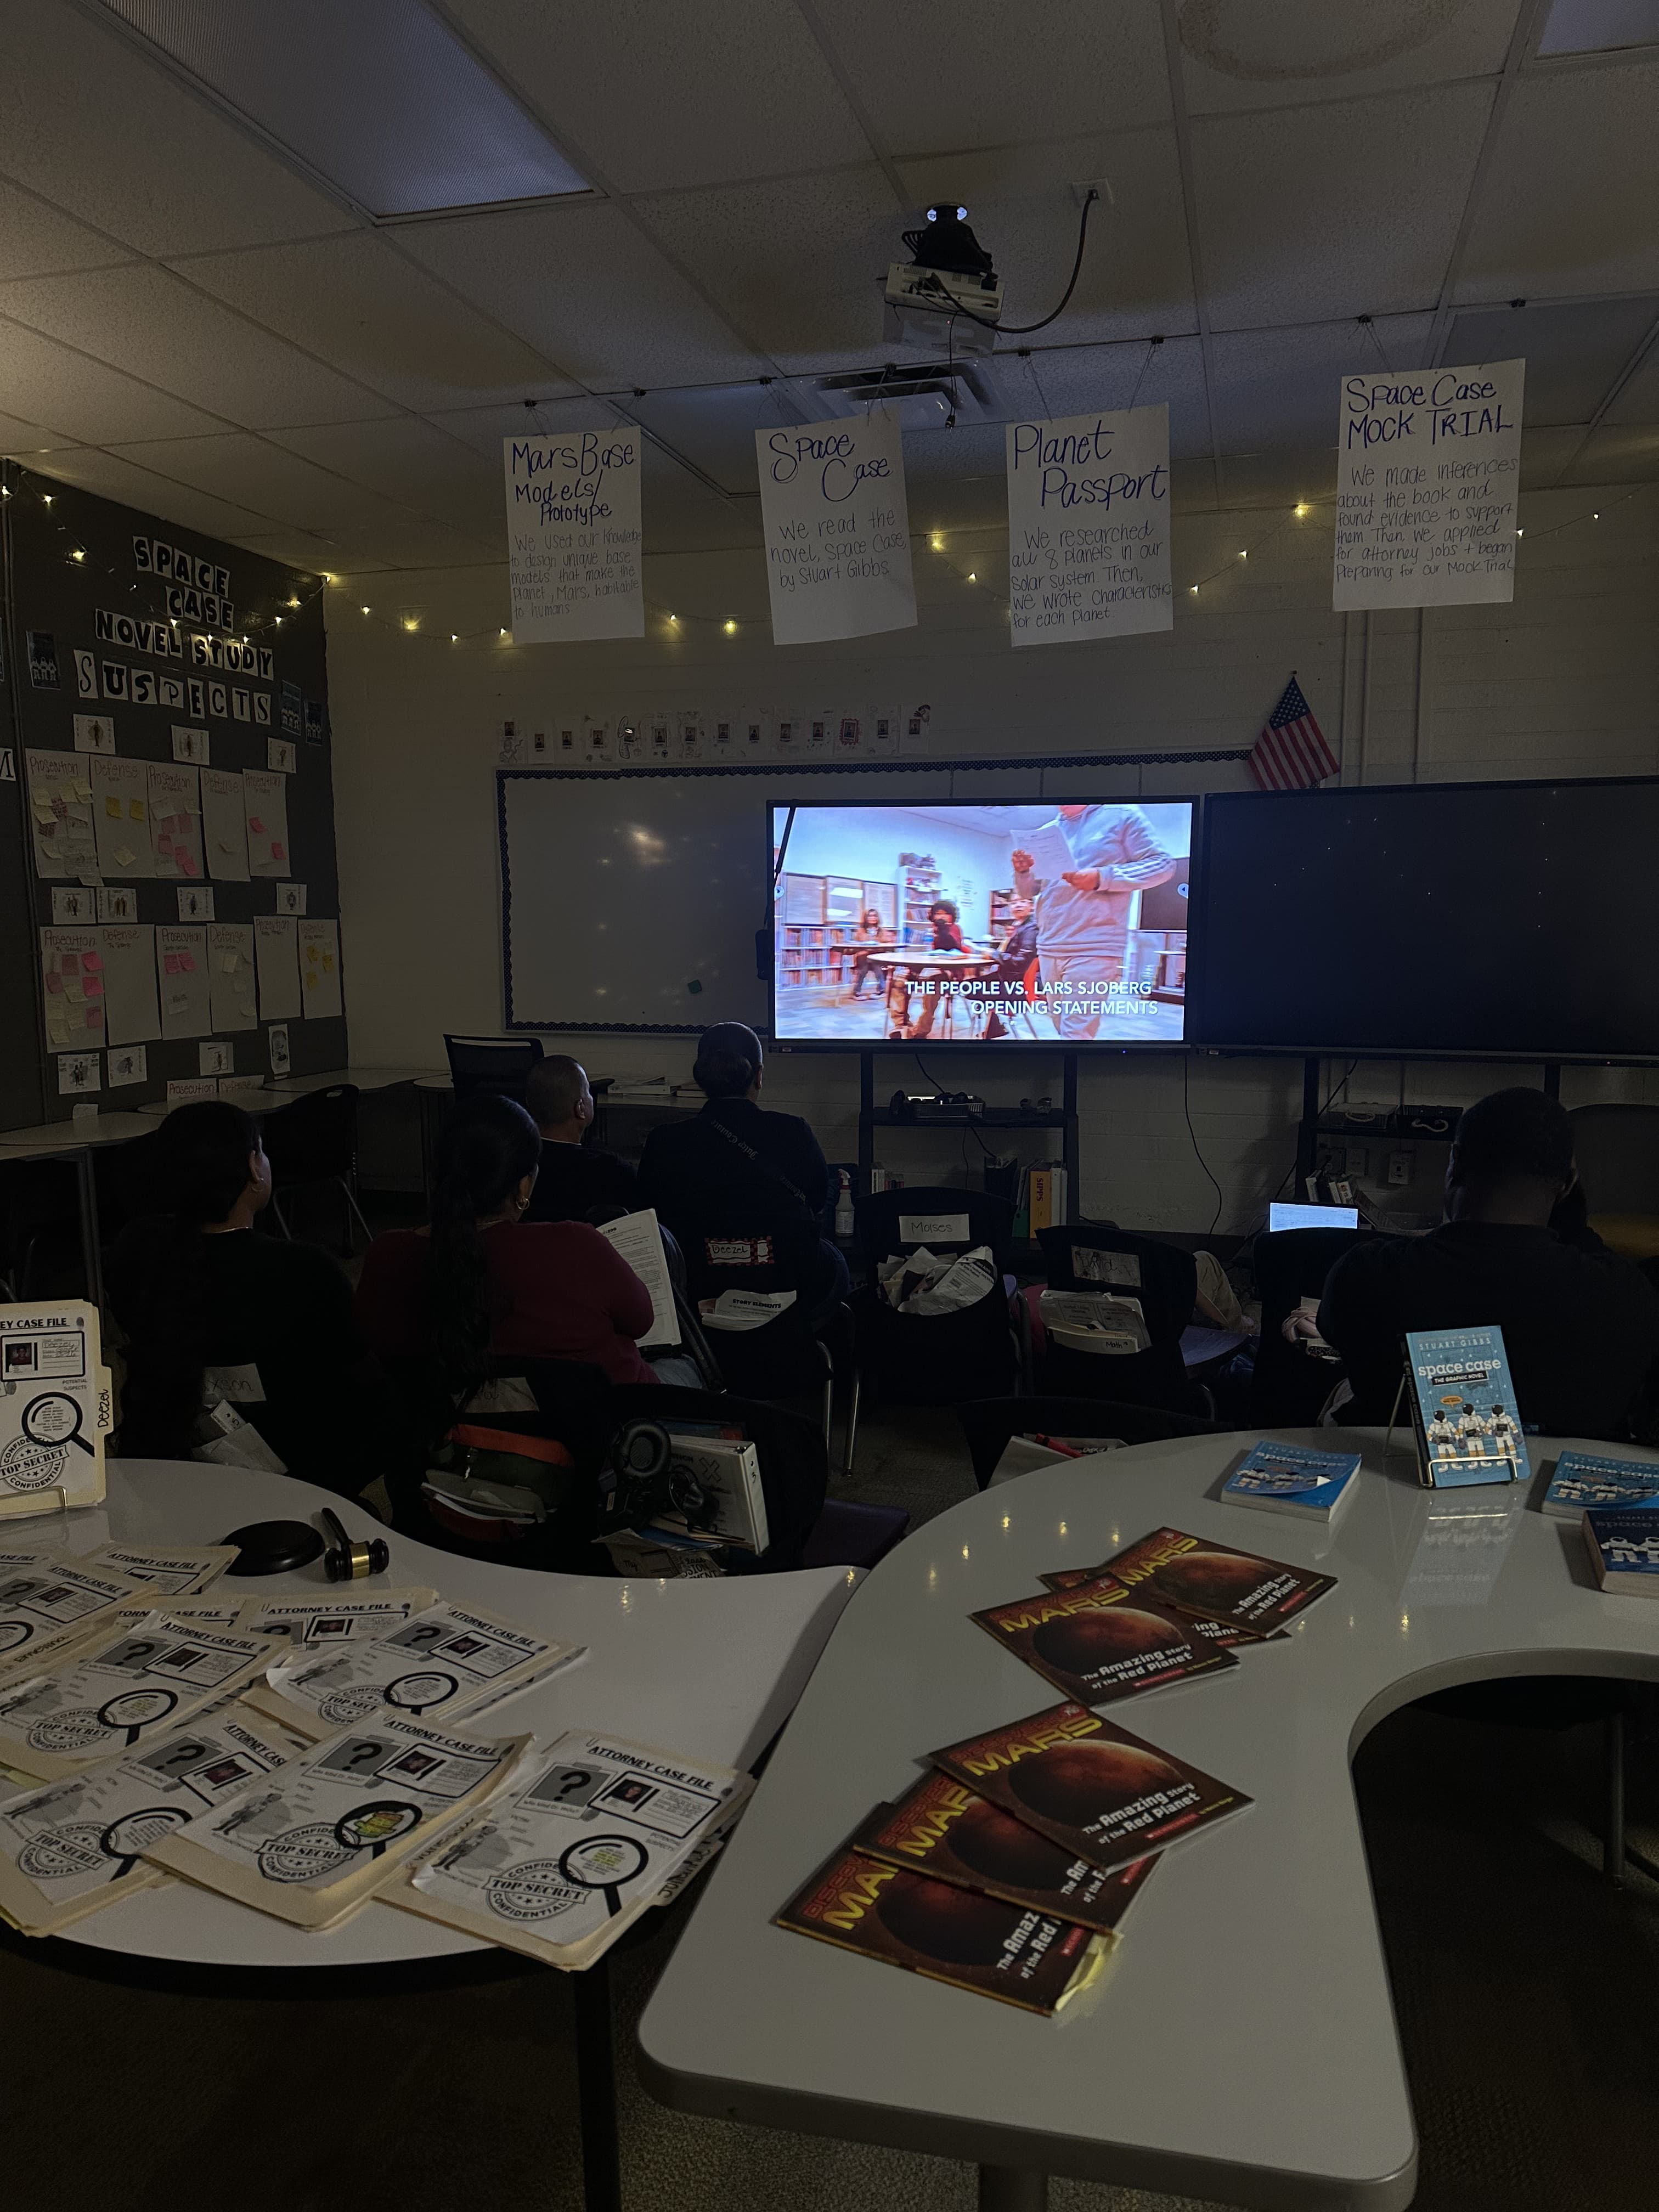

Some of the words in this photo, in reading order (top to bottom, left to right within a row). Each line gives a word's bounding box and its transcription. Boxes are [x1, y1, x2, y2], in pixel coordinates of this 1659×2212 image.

[1346, 378, 1426, 413] Space
[1431, 374, 1497, 407] Case
[1348, 410, 1414, 449] MOCK
[1425, 404, 1514, 445] TRIAL
[513, 442, 578, 478] Mars
[581, 433, 636, 476] Base
[769, 433, 855, 483] Space
[1014, 420, 1115, 470] Planet
[822, 458, 894, 502] Case
[1352, 464, 1374, 487] We
[1385, 466, 1426, 487] made
[1438, 458, 1518, 480] inferences
[1041, 465, 1169, 511] Passport
[1338, 493, 1376, 509] about
[1385, 491, 1406, 509] the
[1413, 488, 1452, 505] book
[1458, 479, 1494, 500] and
[541, 502, 612, 526] Prototype
[819, 514, 856, 537] read
[869, 507, 895, 529] the
[1338, 511, 1373, 527] found
[1381, 510, 1441, 526] evidence
[1446, 505, 1459, 520] to
[1466, 503, 1513, 520] support
[515, 535, 536, 551] We
[544, 533, 573, 549] used
[579, 533, 599, 548] our
[1024, 526, 1049, 549] We
[1060, 520, 1154, 548] researched
[1443, 519, 1500, 543] applied
[511, 555, 520, 567] to
[525, 555, 556, 570] design
[563, 553, 599, 571] unique
[606, 551, 631, 564] base
[771, 548, 820, 563] novel,
[873, 532, 907, 552] Case,
[1045, 550, 1058, 569] 8
[1121, 545, 1132, 560] in
[1140, 542, 1163, 558] our
[1335, 548, 1352, 561] for
[1362, 546, 1418, 564] attorney
[1430, 544, 1456, 560] jobs
[1479, 543, 1512, 558] began
[134, 537, 228, 596] SPACE
[512, 570, 549, 585] models
[559, 569, 580, 582] that
[585, 567, 614, 581] make
[620, 566, 635, 577] the
[779, 570, 795, 592] by
[799, 565, 840, 584] Stuart
[847, 557, 889, 578] Gibbs.
[1400, 564, 1413, 577] for
[1423, 563, 1441, 575] our
[557, 586, 590, 600] Mars,
[595, 579, 639, 596] habitable
[1043, 591, 1082, 608] wrote
[170, 589, 233, 630] CASE
[513, 607, 524, 619] to
[1014, 613, 1031, 628] for
[1036, 608, 1064, 627] each
[96, 612, 181, 656] NOVEL
[194, 640, 273, 678] STUDY
[78, 655, 271, 722] SUSPECTS
[905, 981, 936, 994] THE
[940, 981, 1000, 995] PEOPLE
[1004, 981, 1029, 995] VS.
[1034, 982, 1073, 994] LARS
[1077, 981, 1152, 995] SJOBERG
[970, 1001, 1048, 1014] OPENING
[1053, 1001, 1158, 1014] STATEMENTS
[170, 1084, 214, 1094] Prosecution
[16, 1319, 43, 1327] CASE
[1419, 1340, 1455, 1351] STUART
[1418, 1362, 1464, 1379] space
[1465, 1358, 1502, 1371] case
[1, 1463, 22, 1476] TOP
[23, 1448, 64, 1469] SECRET
[10, 1460, 61, 1489] CONFIDENTIAL
[1117, 1538, 1199, 1587] MARS
[1238, 1579, 1276, 1610] Amazing
[1258, 1593, 1278, 1612] Red
[1273, 1578, 1301, 1600] Planet
[268, 1605, 332, 1615] ATTORNEY
[335, 1605, 366, 1613] CASE
[998, 1588, 1130, 1633] MARS
[161, 1622, 212, 1639] ATTORNEY
[211, 1637, 236, 1645] CASE
[235, 1640, 257, 1649] FILE
[1080, 1671, 1098, 1681] The
[1097, 1650, 1165, 1677] Amazing
[1166, 1644, 1192, 1657] story
[1103, 1677, 1118, 1686] the
[1119, 1666, 1145, 1681] Red
[1148, 1651, 1194, 1671] Planet
[385, 1720, 444, 1746] ATTORNEY
[443, 1736, 476, 1753] CASE
[473, 1743, 497, 1757] FILE
[962, 1716, 1104, 1778] MARS
[588, 1746, 654, 1770] ATTORNEY
[654, 1764, 687, 1781] CASE
[686, 1776, 713, 1790] FILE
[1082, 1822, 1103, 1836] The
[1099, 1791, 1169, 1827] Amazing
[1166, 1781, 1195, 1797] story
[1098, 1835, 1111, 1846] of
[1109, 1827, 1126, 1839] the
[1124, 1814, 1154, 1833] Red
[1155, 1792, 1202, 1818] Planet
[266, 1842, 296, 1857] TOP
[296, 1844, 352, 1861] SECRET
[493, 1879, 522, 1890] TOP
[523, 1882, 584, 1900] SECRET
[494, 1893, 568, 1918] CONFIDENTIAL
